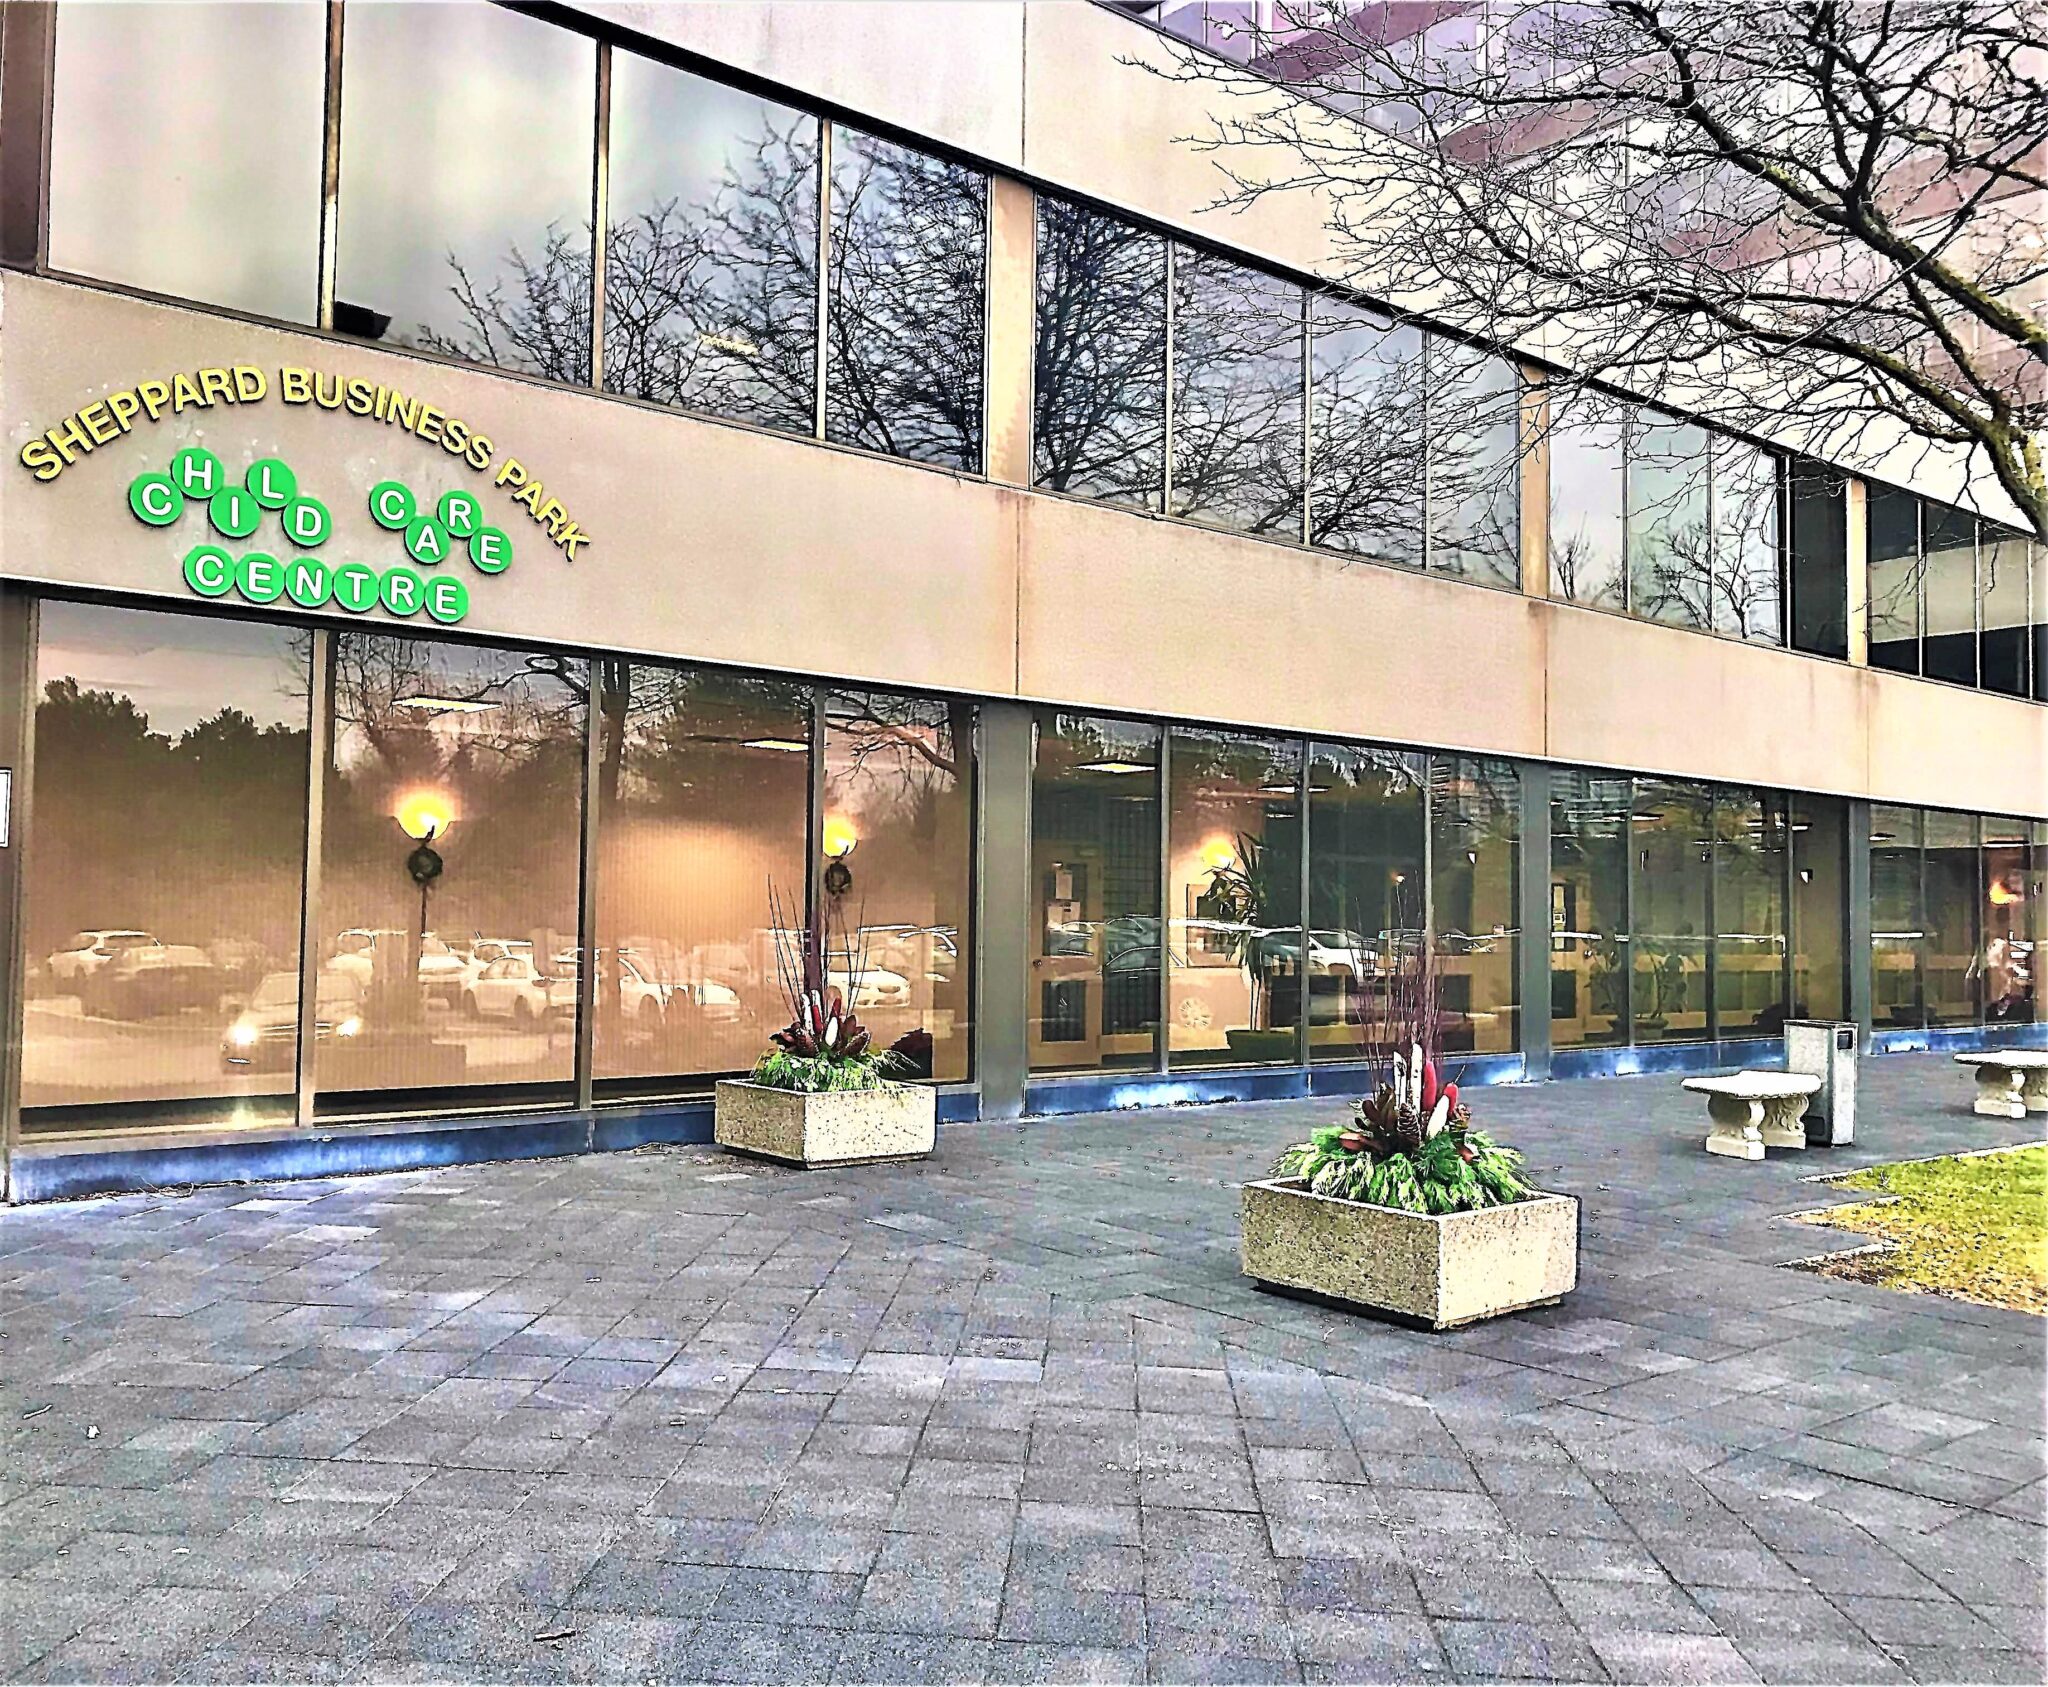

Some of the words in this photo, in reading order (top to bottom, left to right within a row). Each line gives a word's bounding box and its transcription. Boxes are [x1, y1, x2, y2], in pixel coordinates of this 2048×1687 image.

[20, 366, 267, 482] SHEPPARD
[281, 368, 494, 470] BUSINESS
[496, 458, 591, 562] PARK
[140, 456, 324, 537] CHILD
[378, 488, 504, 563] CARE
[193, 552, 460, 617] CENTRE
